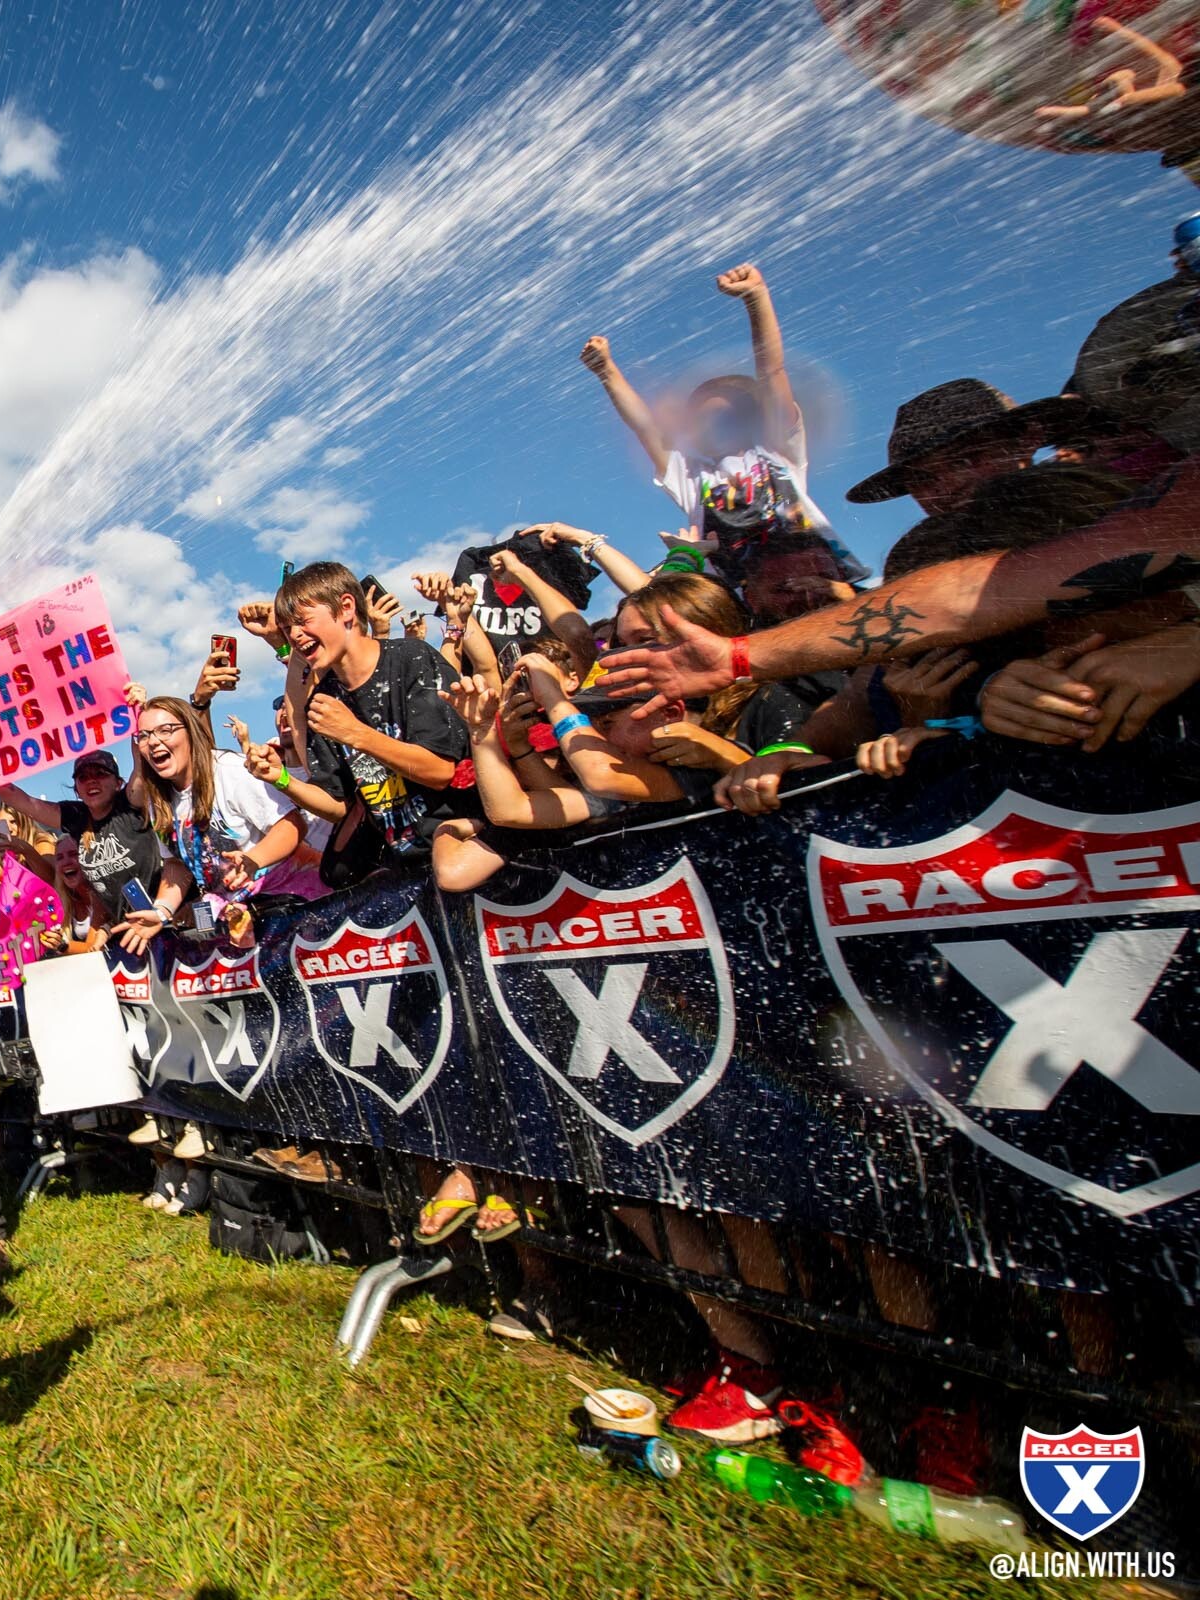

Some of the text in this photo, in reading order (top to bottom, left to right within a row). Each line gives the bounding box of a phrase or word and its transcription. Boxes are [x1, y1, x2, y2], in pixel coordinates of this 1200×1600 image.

[469, 573, 488, 605] I
[34, 613, 56, 639] 18
[472, 605, 542, 636] ILFS
[43, 623, 115, 678] THE
[56, 676, 97, 717] IN
[838, 841, 1200, 916] RACE
[492, 906, 688, 952] RACER
[301, 941, 420, 975] RACER
[115, 984, 148, 998] CER
[176, 969, 251, 994] RACER
[200, 1000, 259, 1066] X
[336, 983, 423, 1069] X
[543, 962, 684, 1084] X
[932, 927, 1200, 1116] X
